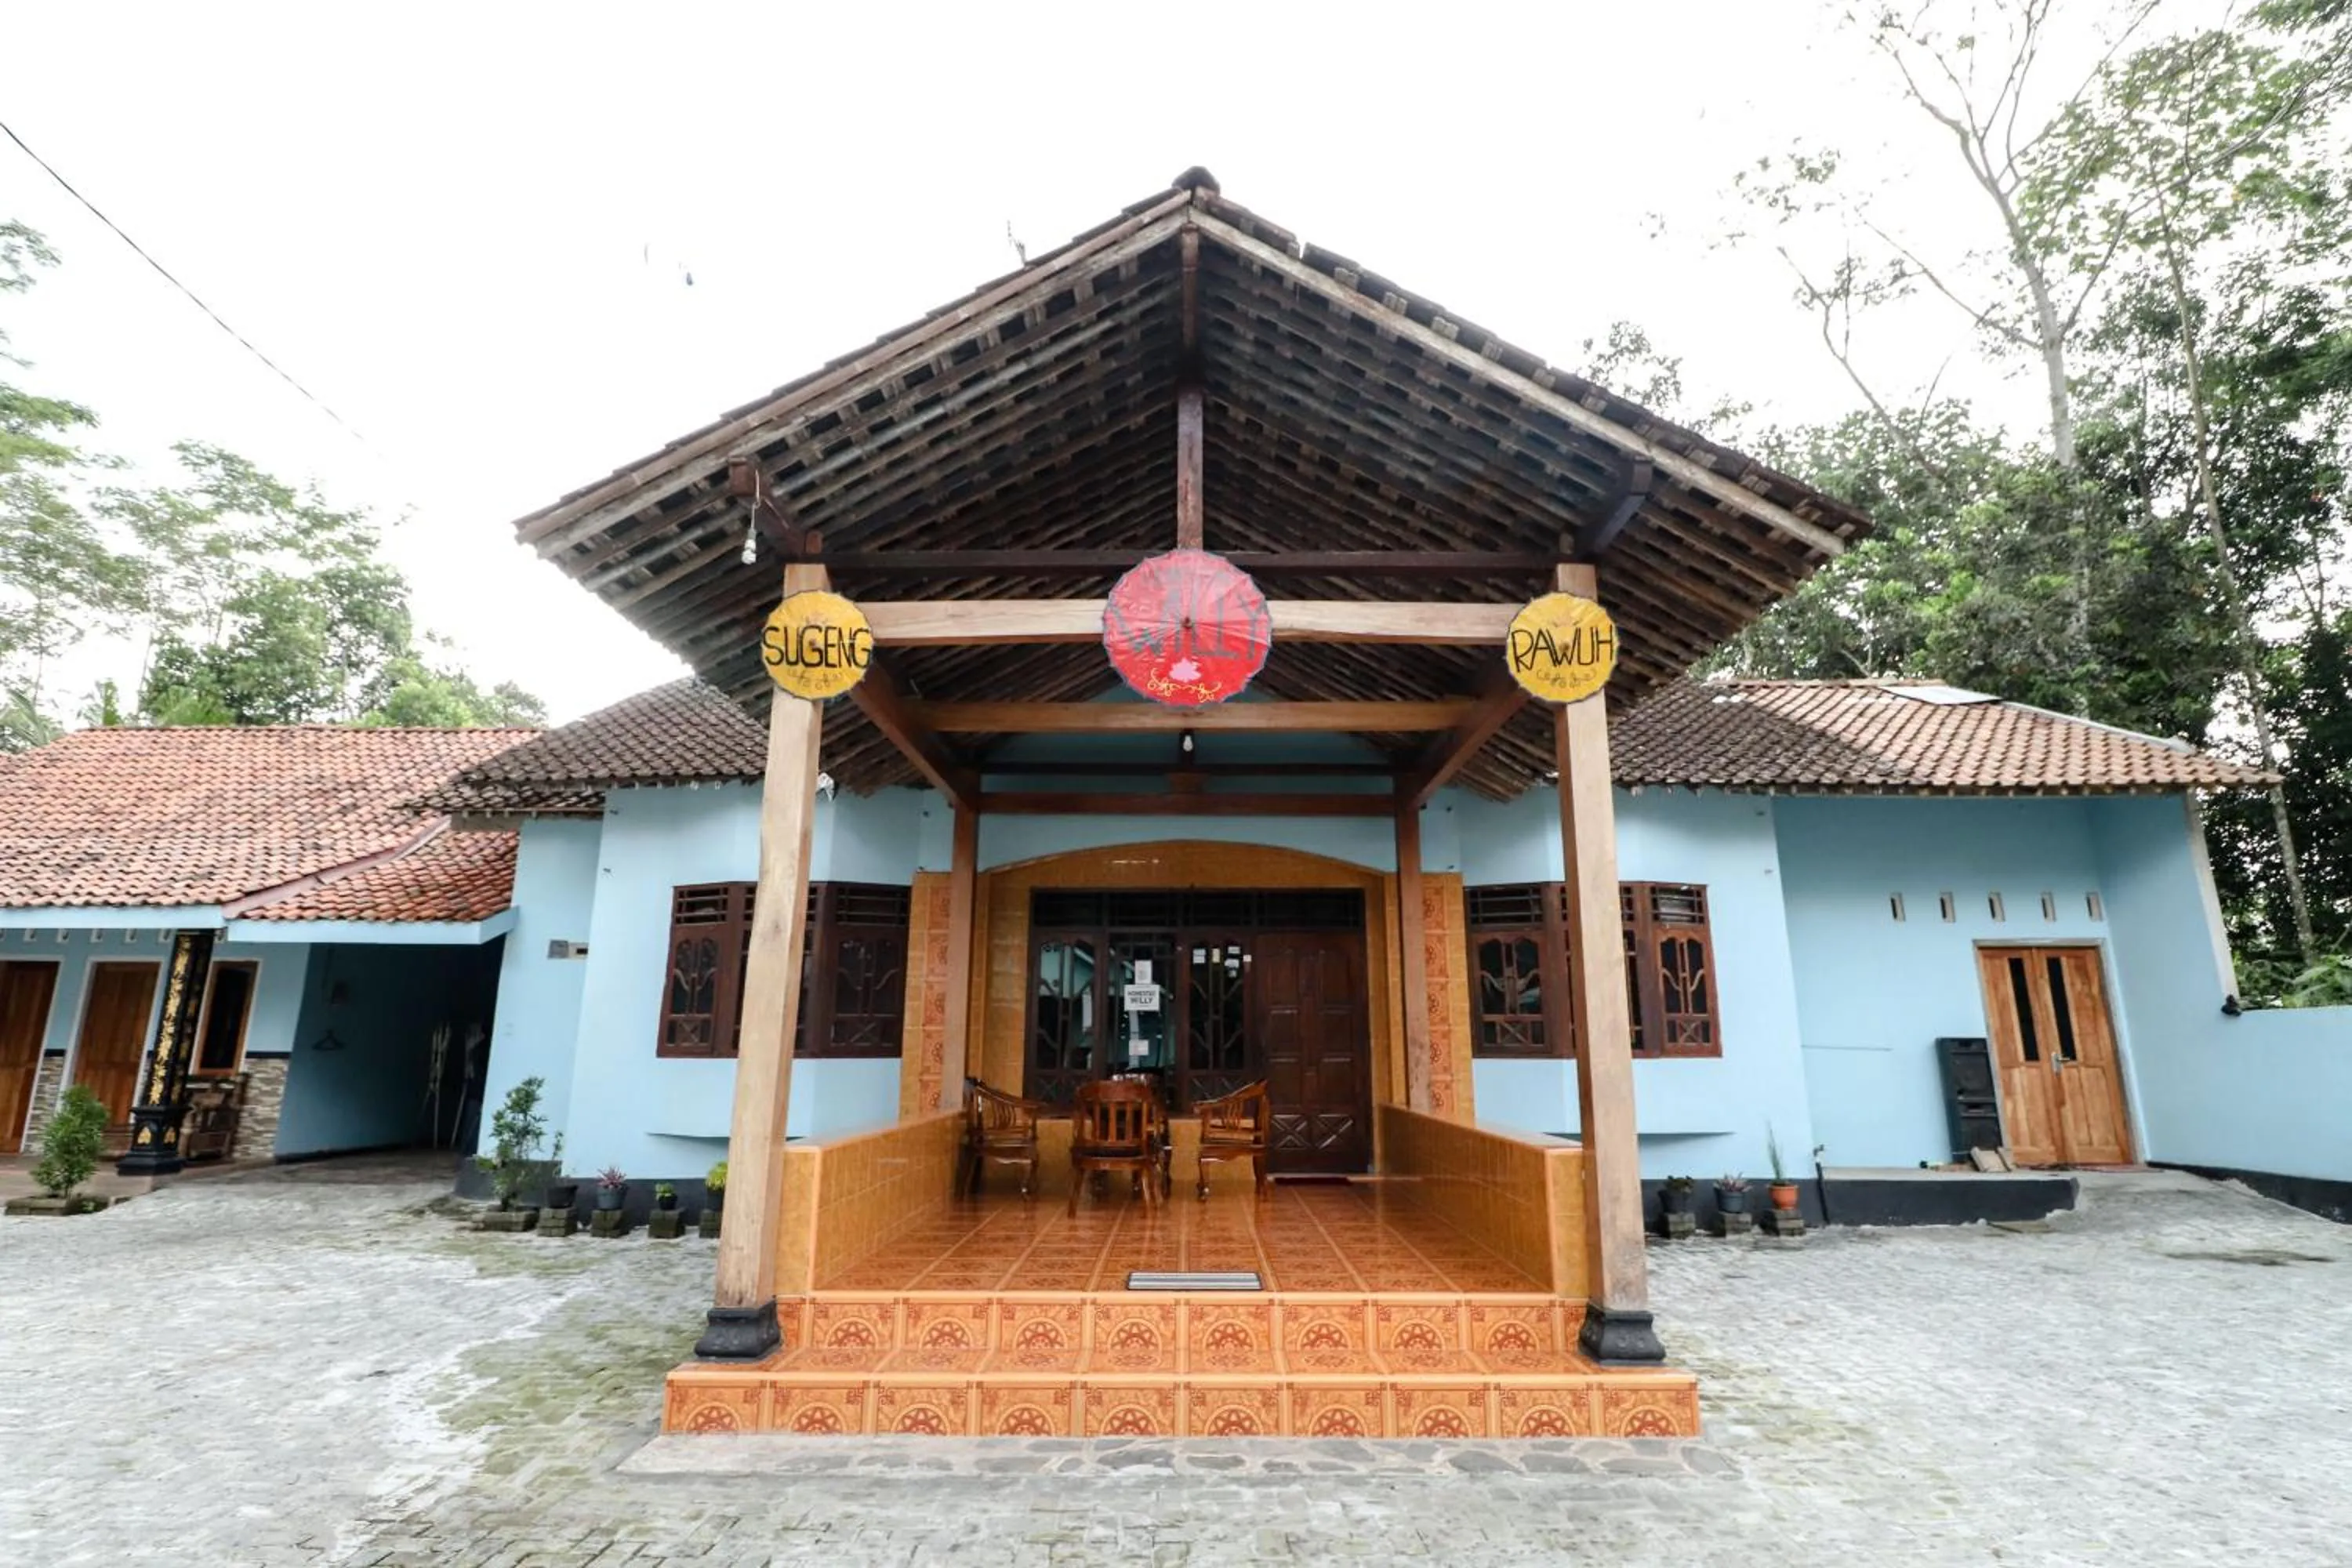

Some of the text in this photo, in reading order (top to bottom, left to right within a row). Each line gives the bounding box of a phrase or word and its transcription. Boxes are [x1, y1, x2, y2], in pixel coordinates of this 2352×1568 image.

[1105, 570, 1271, 661] WILLY
[763, 625, 871, 669] SUGENG
[1511, 624, 1613, 673] RAWUH
